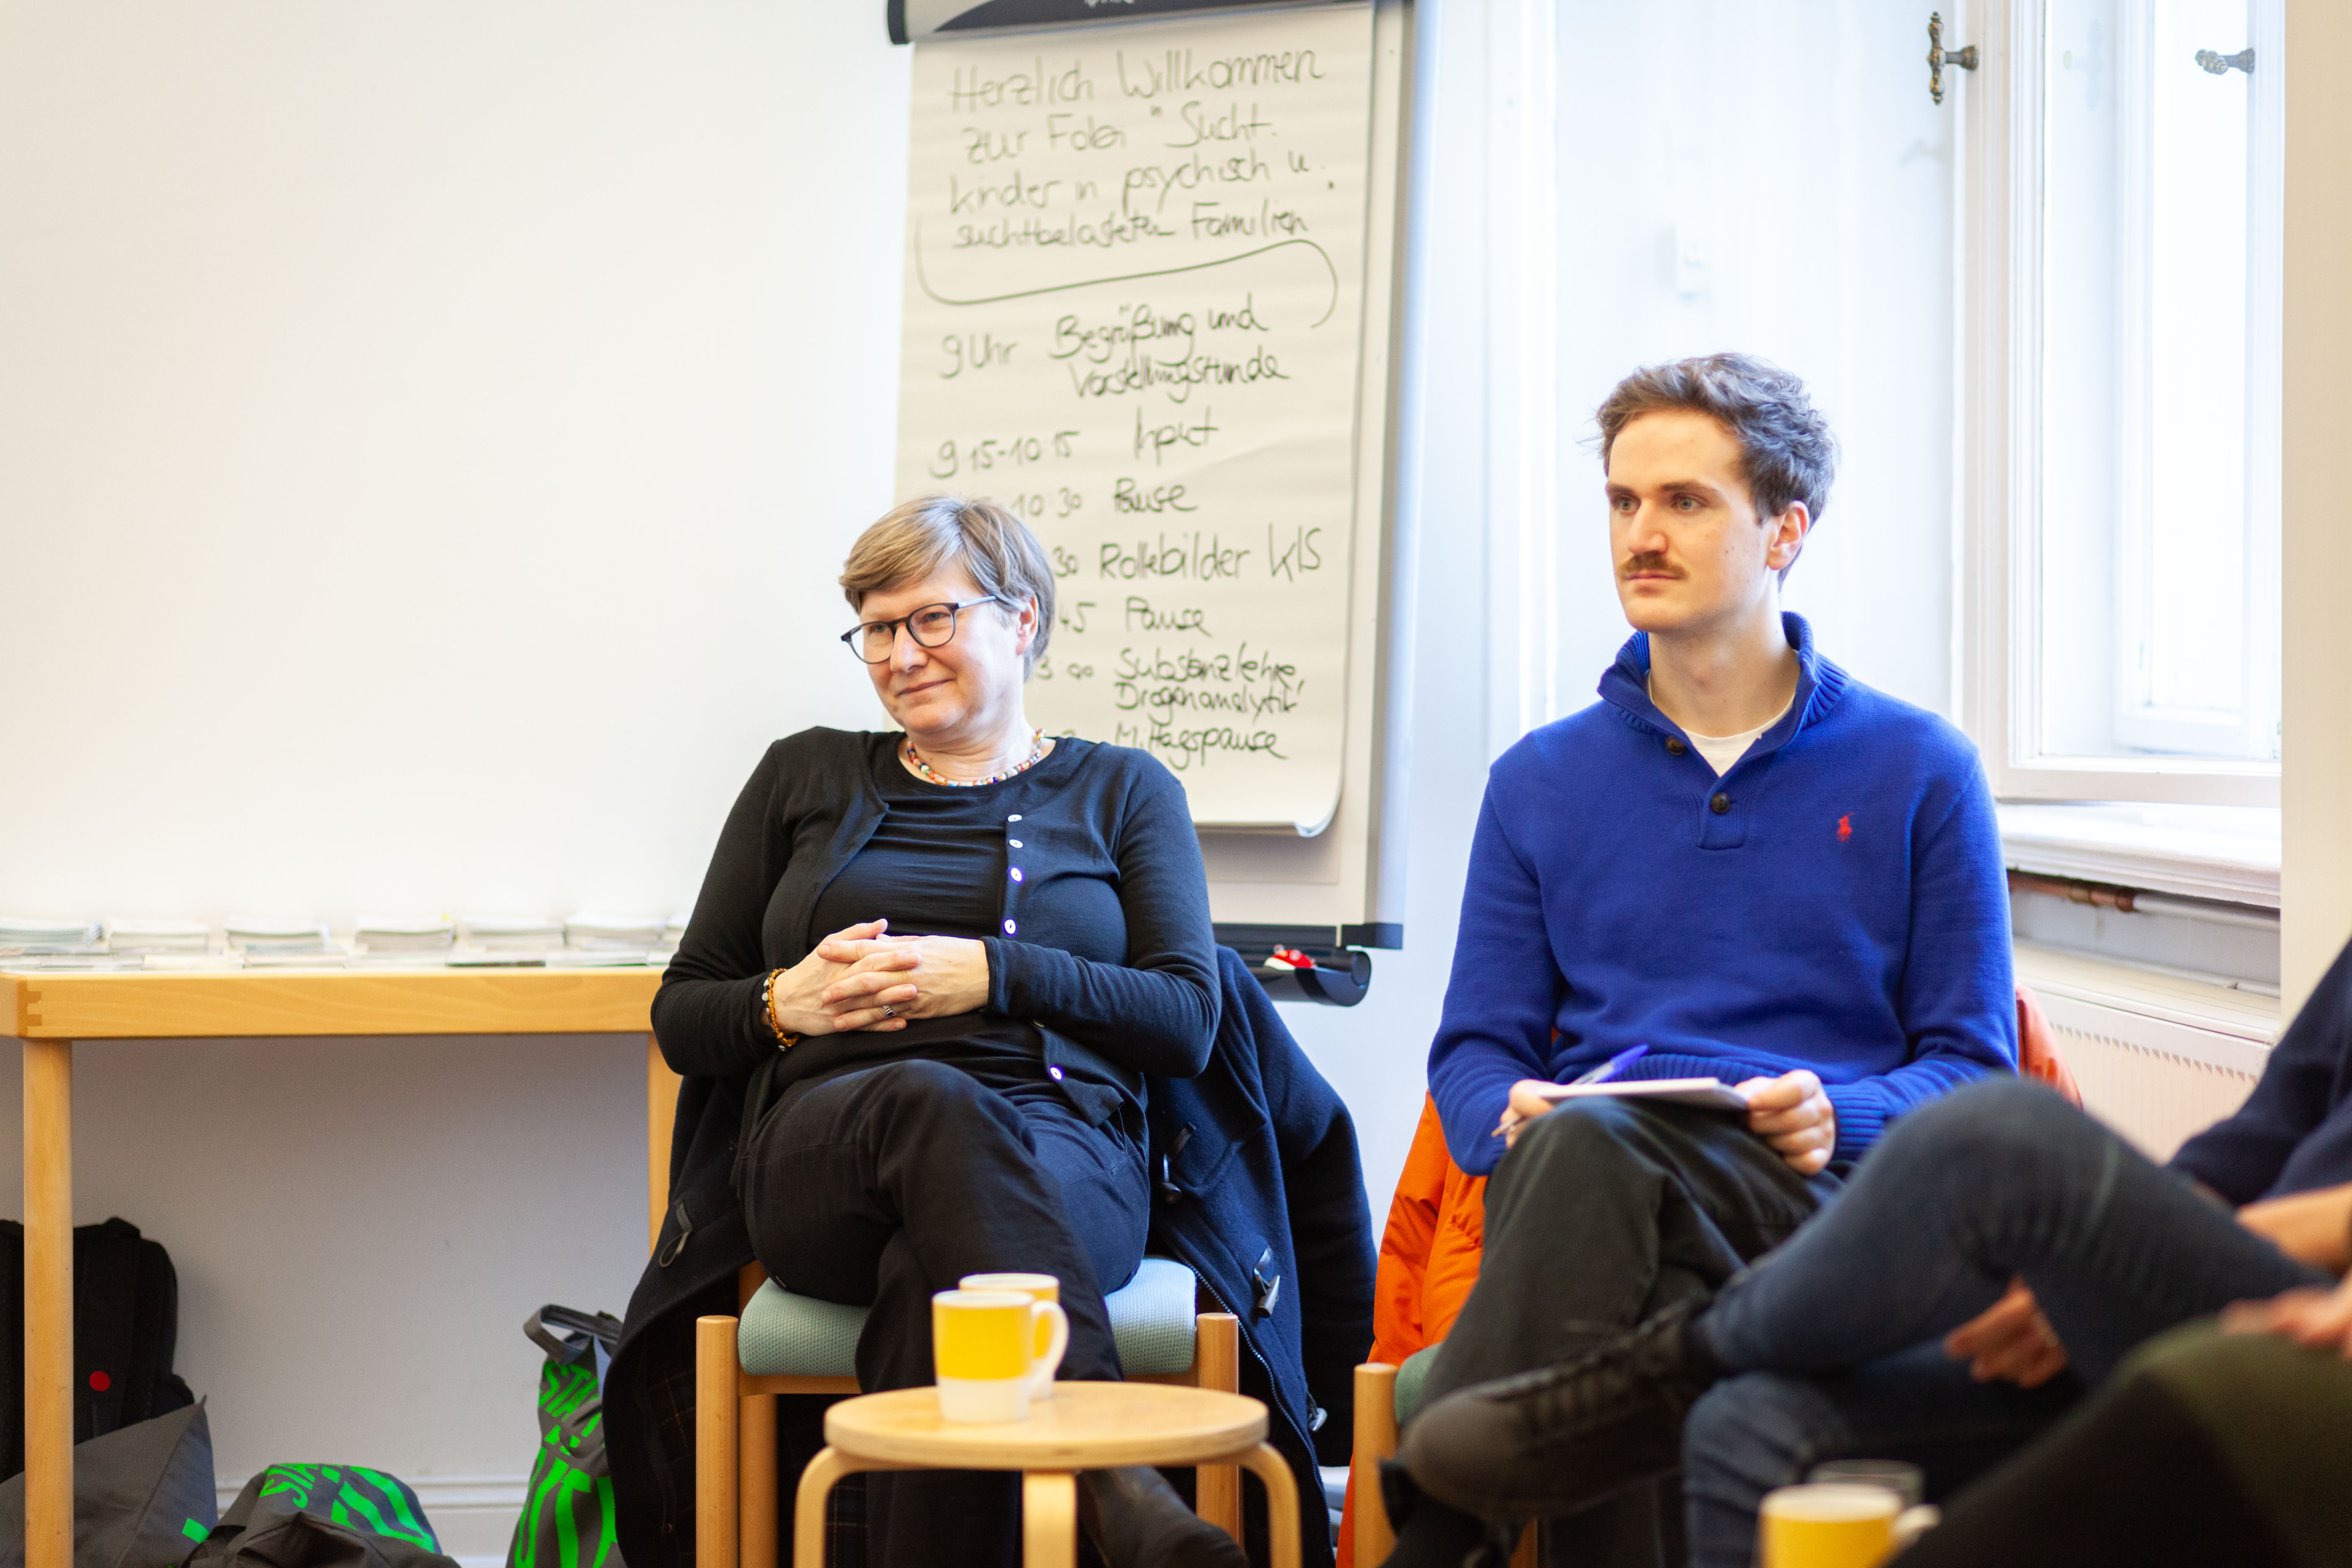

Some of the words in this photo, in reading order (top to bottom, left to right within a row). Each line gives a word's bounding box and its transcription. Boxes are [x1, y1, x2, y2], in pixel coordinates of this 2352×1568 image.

[946, 52, 1094, 113] Herzlich
[1116, 47, 1328, 100] Willkommen
[962, 126, 1030, 164] zur
[1122, 148, 1271, 218] psychisch
[1192, 199, 1308, 240] Familien
[1047, 302, 1196, 374] Begrüßung
[1208, 292, 1270, 332] und
[1133, 405, 1220, 468] Input
[1113, 477, 1199, 514] Pause
[1125, 595, 1214, 638] Pause
